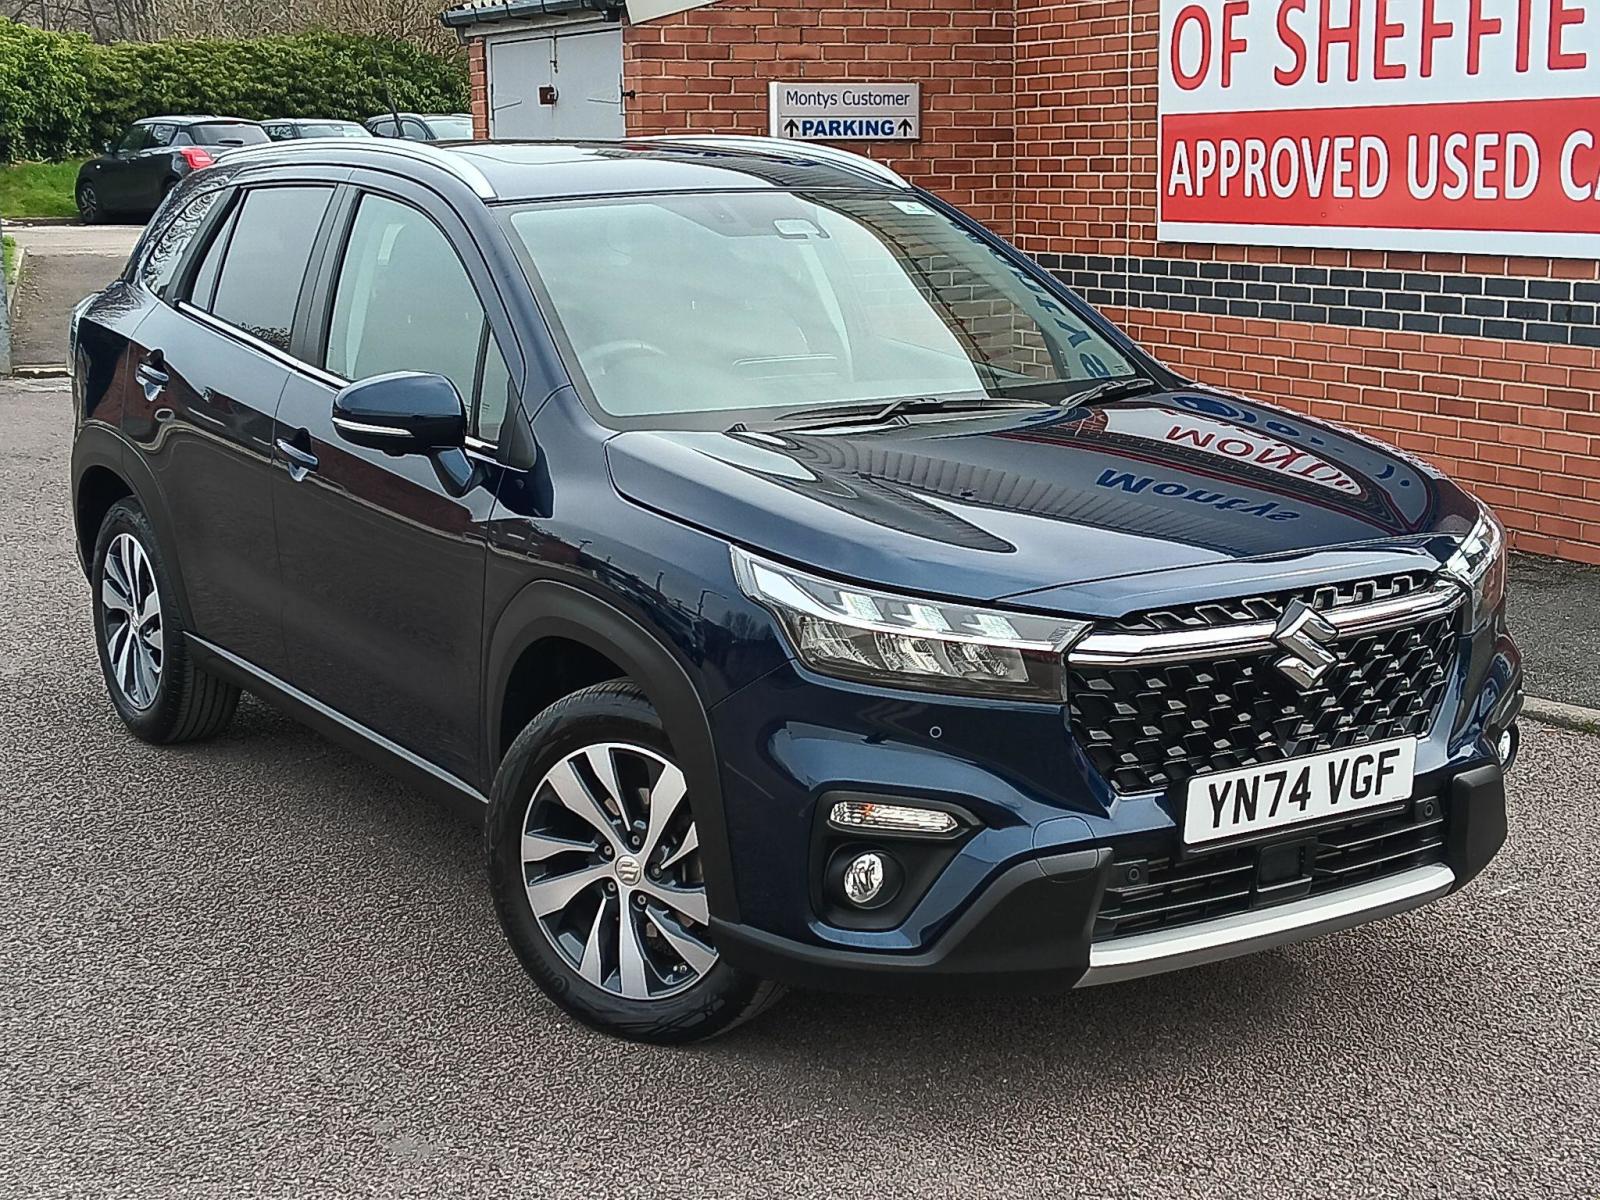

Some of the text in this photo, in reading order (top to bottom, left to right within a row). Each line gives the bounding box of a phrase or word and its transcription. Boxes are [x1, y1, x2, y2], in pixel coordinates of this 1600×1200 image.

[1170, 0, 1587, 90] OF SHEFFIE
[786, 90, 910, 109] Montys Customer
[802, 120, 894, 136] PARKING
[1168, 128, 1600, 201] APPROVED USED C
[1208, 748, 1401, 829] YN74 VGF
